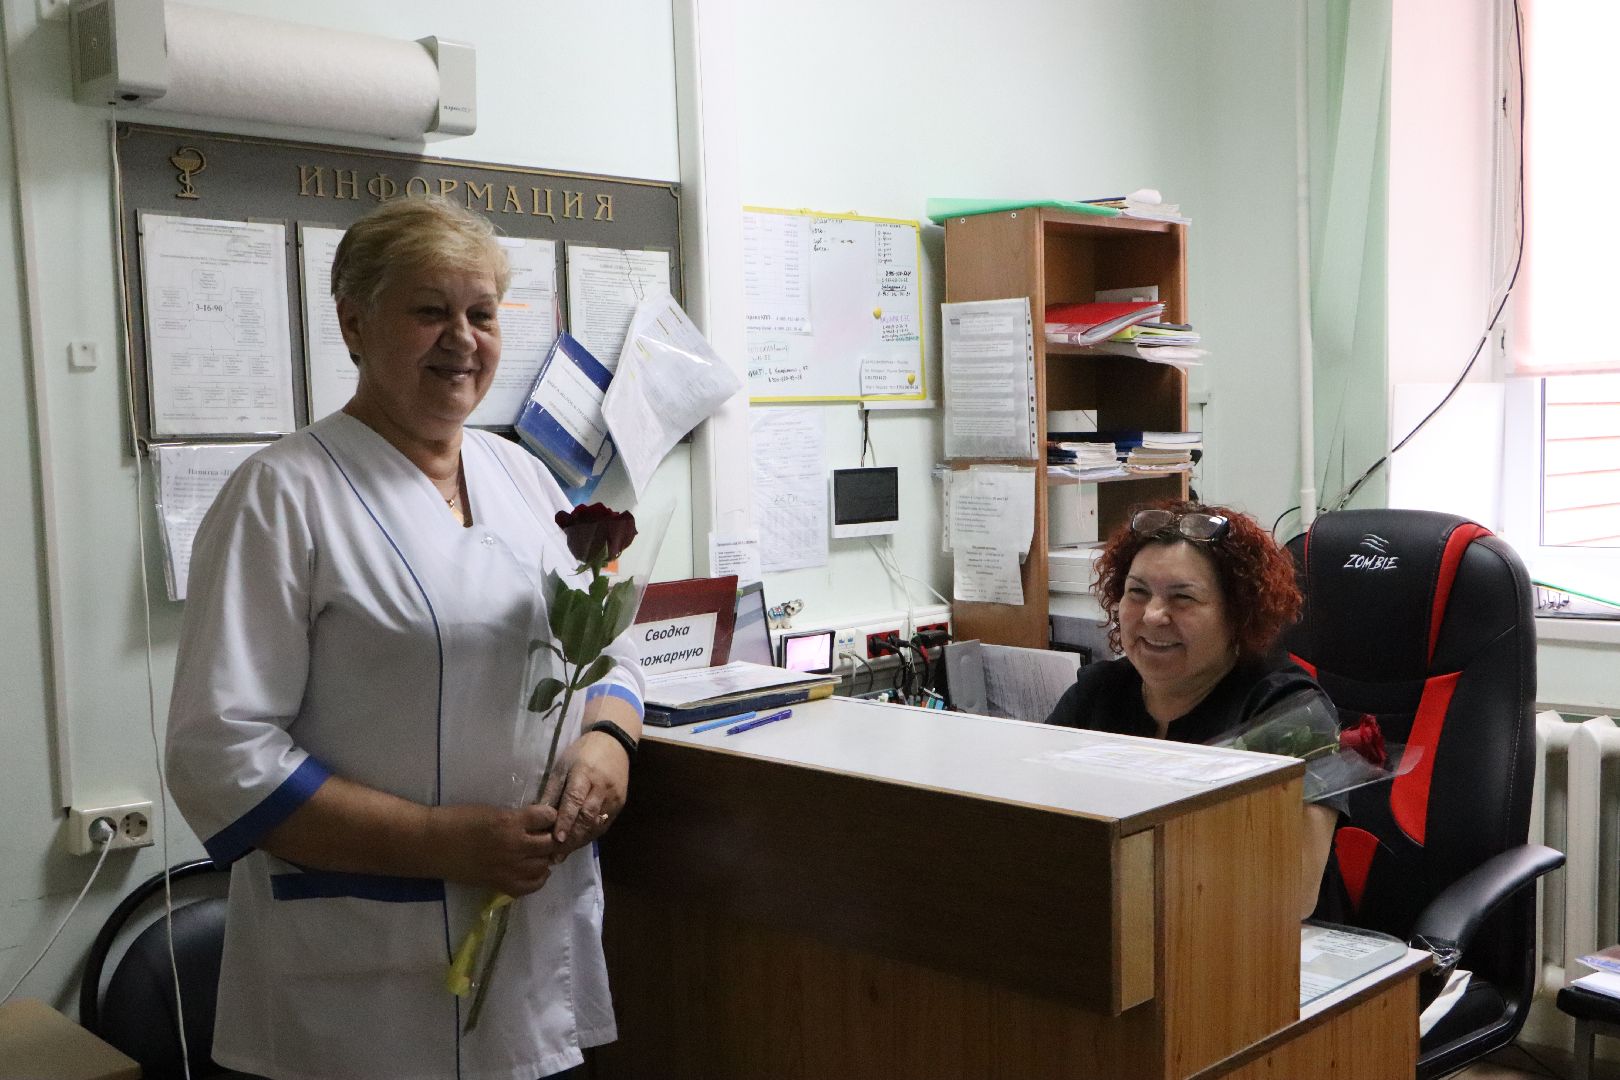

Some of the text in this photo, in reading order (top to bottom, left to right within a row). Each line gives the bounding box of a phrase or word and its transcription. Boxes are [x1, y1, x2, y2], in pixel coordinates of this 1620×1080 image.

[297, 164, 614, 223] ИНФОРМАЦИЯ
[195, 303, 223, 312] 3-16-90
[1343, 554, 1400, 572] ZOMBIE
[645, 624, 690, 642] Сводка
